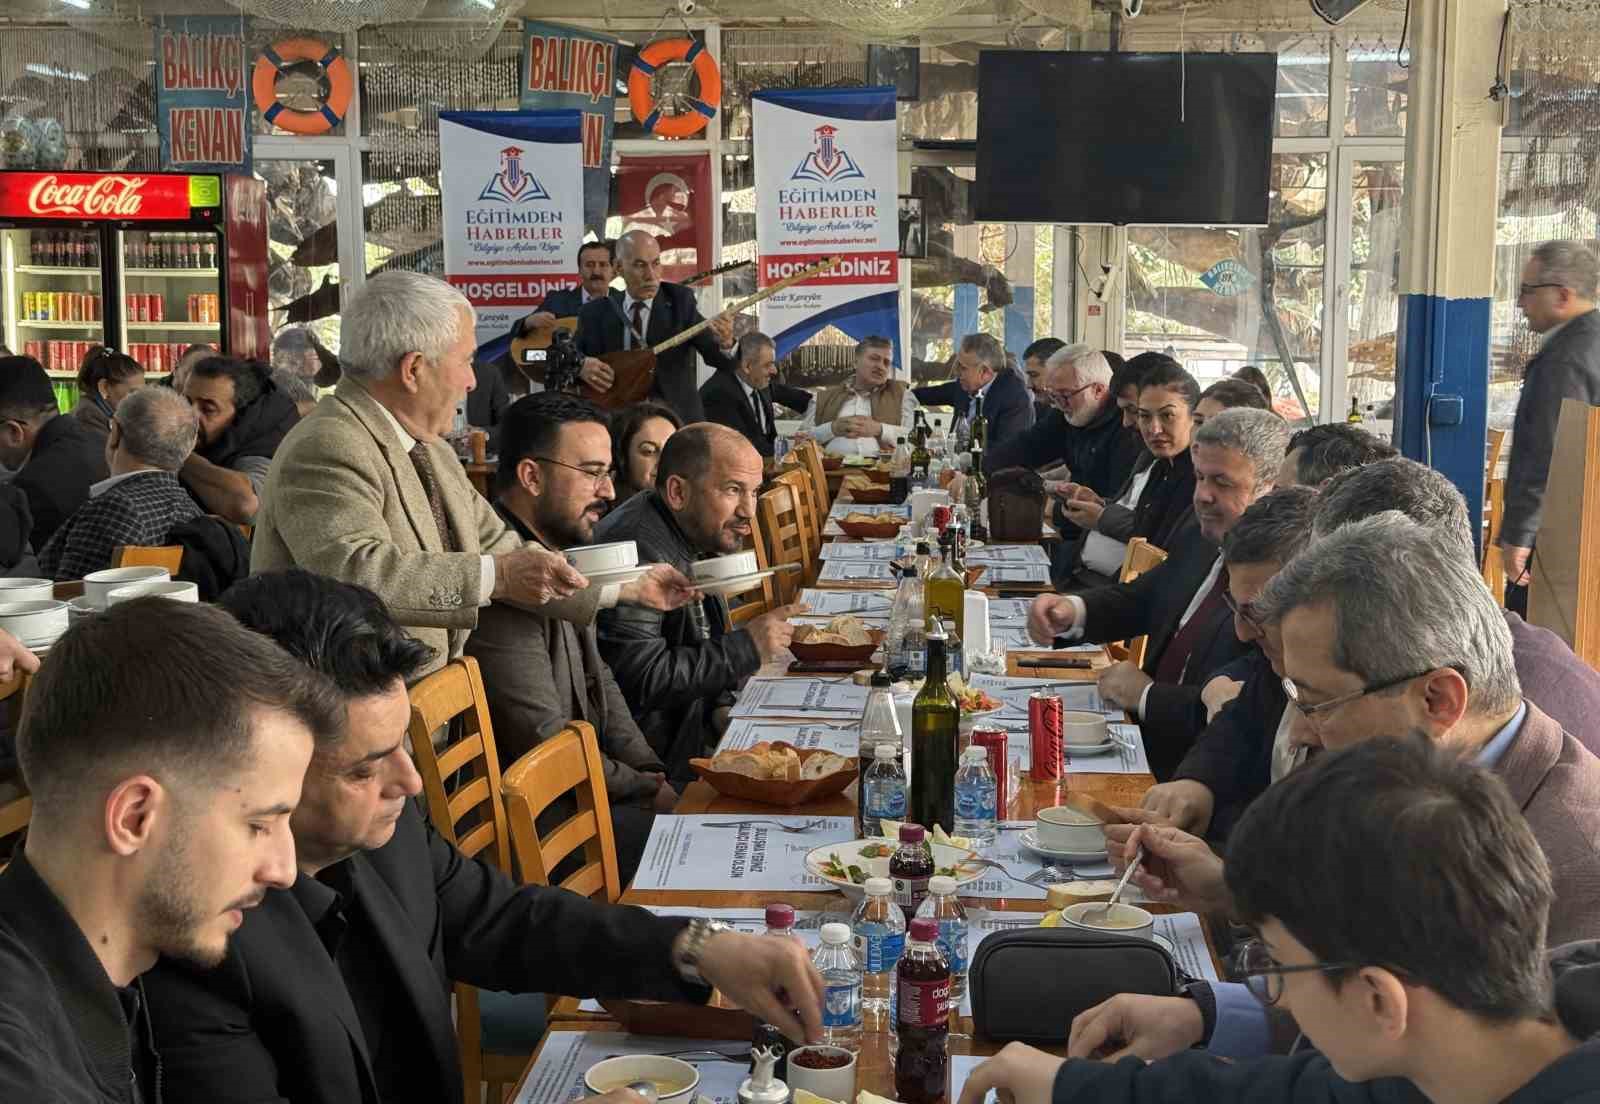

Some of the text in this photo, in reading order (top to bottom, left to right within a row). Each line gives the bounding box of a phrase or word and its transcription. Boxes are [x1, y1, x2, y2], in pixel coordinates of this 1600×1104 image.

[161, 31, 245, 98] BALIKÇI
[528, 35, 615, 103] BALIKÇI
[169, 108, 243, 164] KENAN
[28, 176, 147, 215] Coca-Cola
[779, 187, 876, 204] EĞİTİMDEN
[466, 208, 562, 225] EĞİTİMDEN
[779, 206, 877, 220] HABERLER
[466, 226, 562, 241] HABERLER
